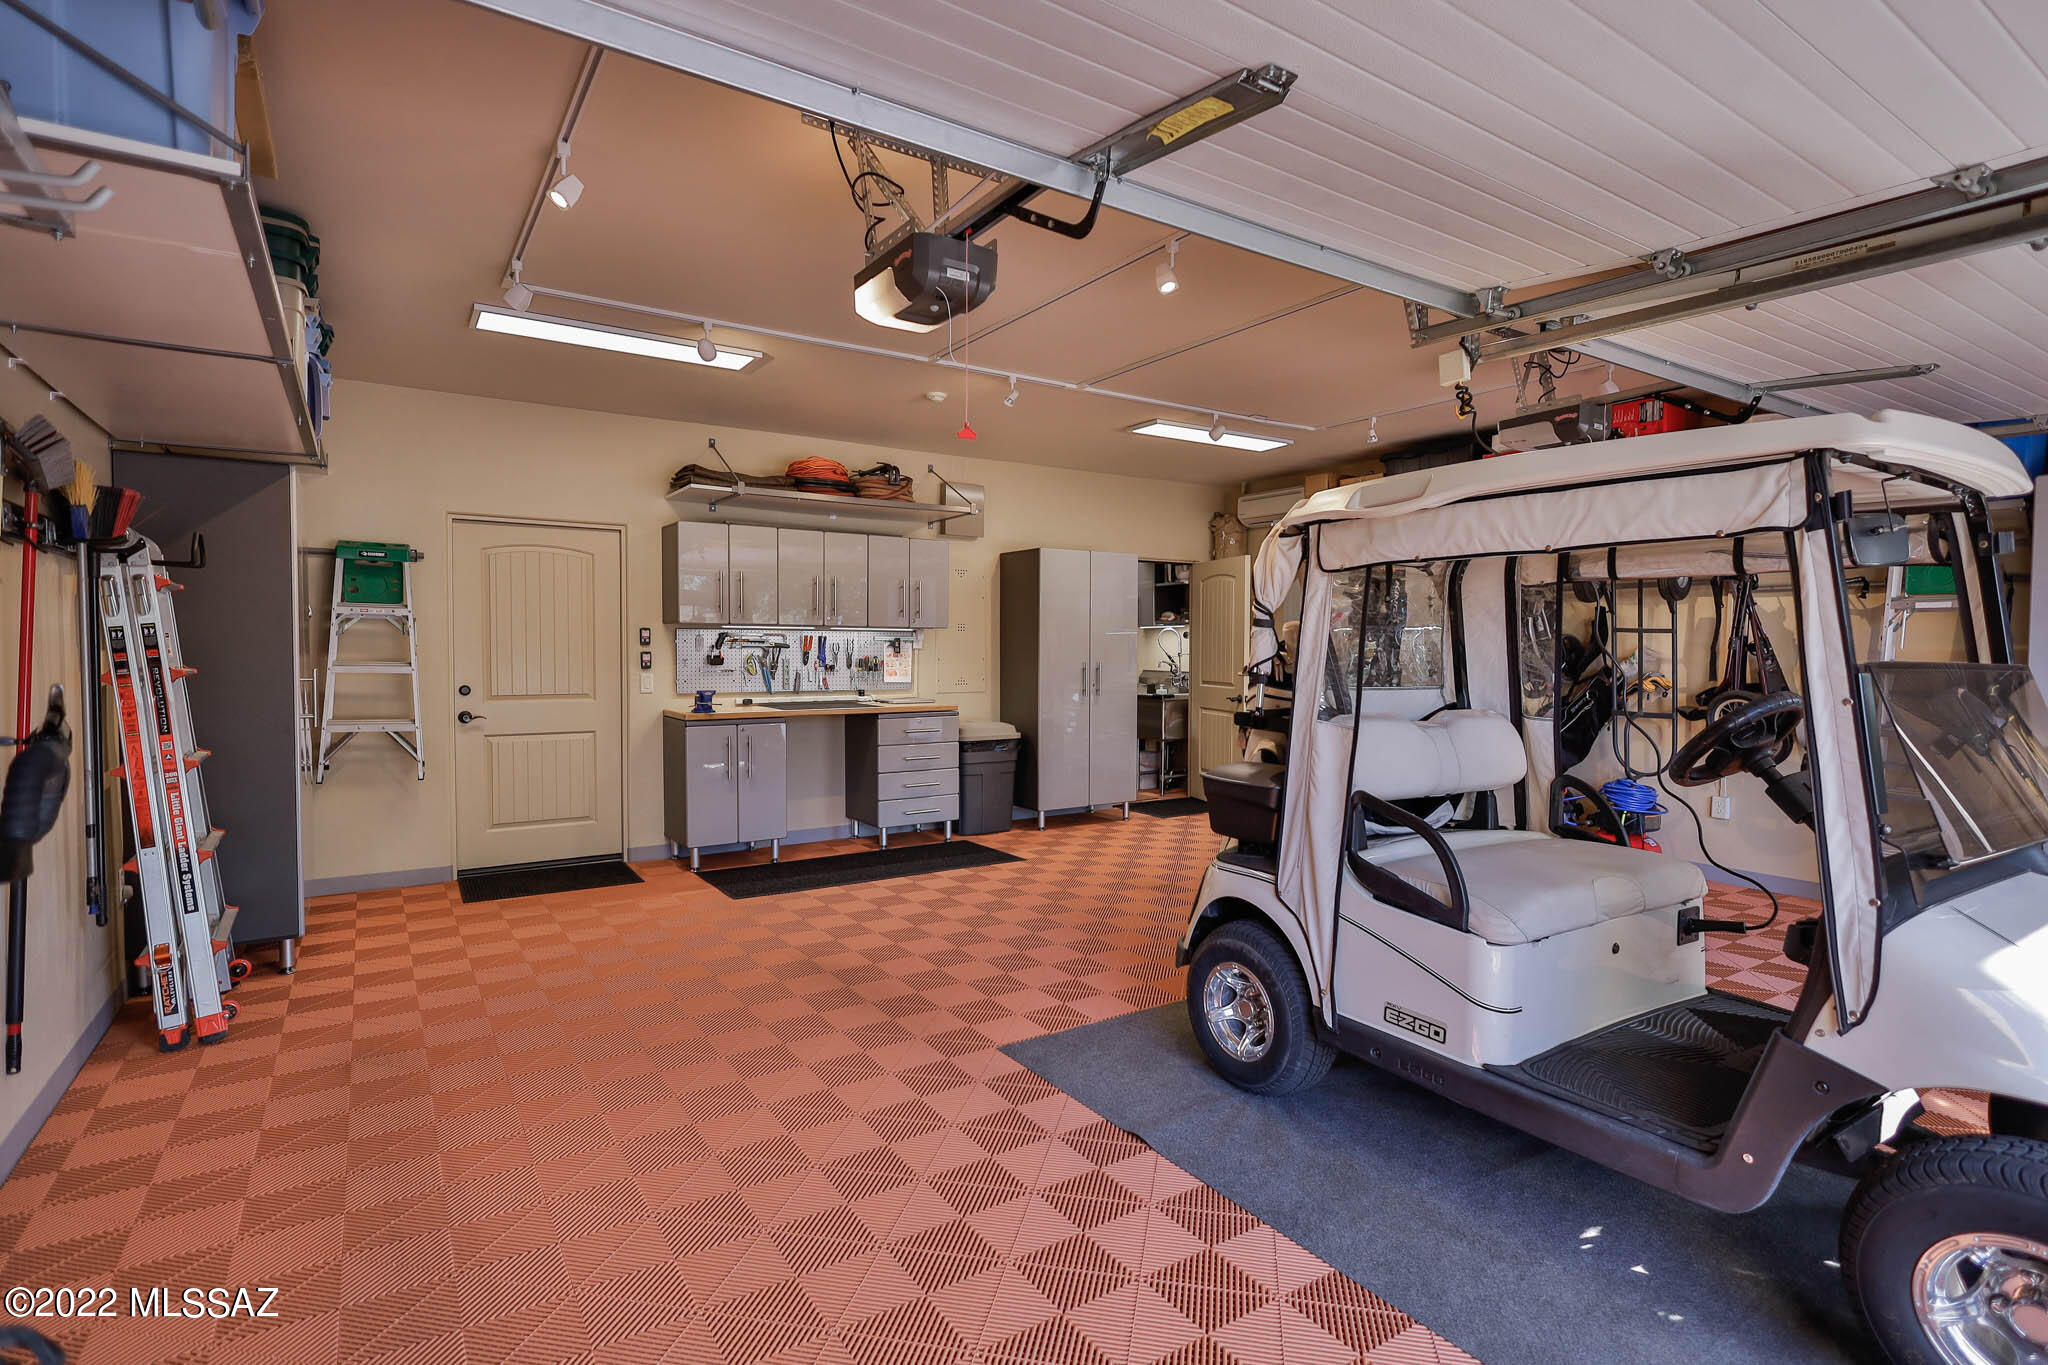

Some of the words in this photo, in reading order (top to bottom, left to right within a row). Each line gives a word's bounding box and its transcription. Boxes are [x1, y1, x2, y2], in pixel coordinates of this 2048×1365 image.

[152, 667, 168, 733] REVOLUTION
[170, 791, 181, 816] Little
[174, 816, 184, 840] Giant
[178, 839, 190, 873] Ladder
[183, 873, 195, 912] Systems
[160, 970, 171, 1014] RATCHET
[1385, 1009, 1446, 1043] EZGO
